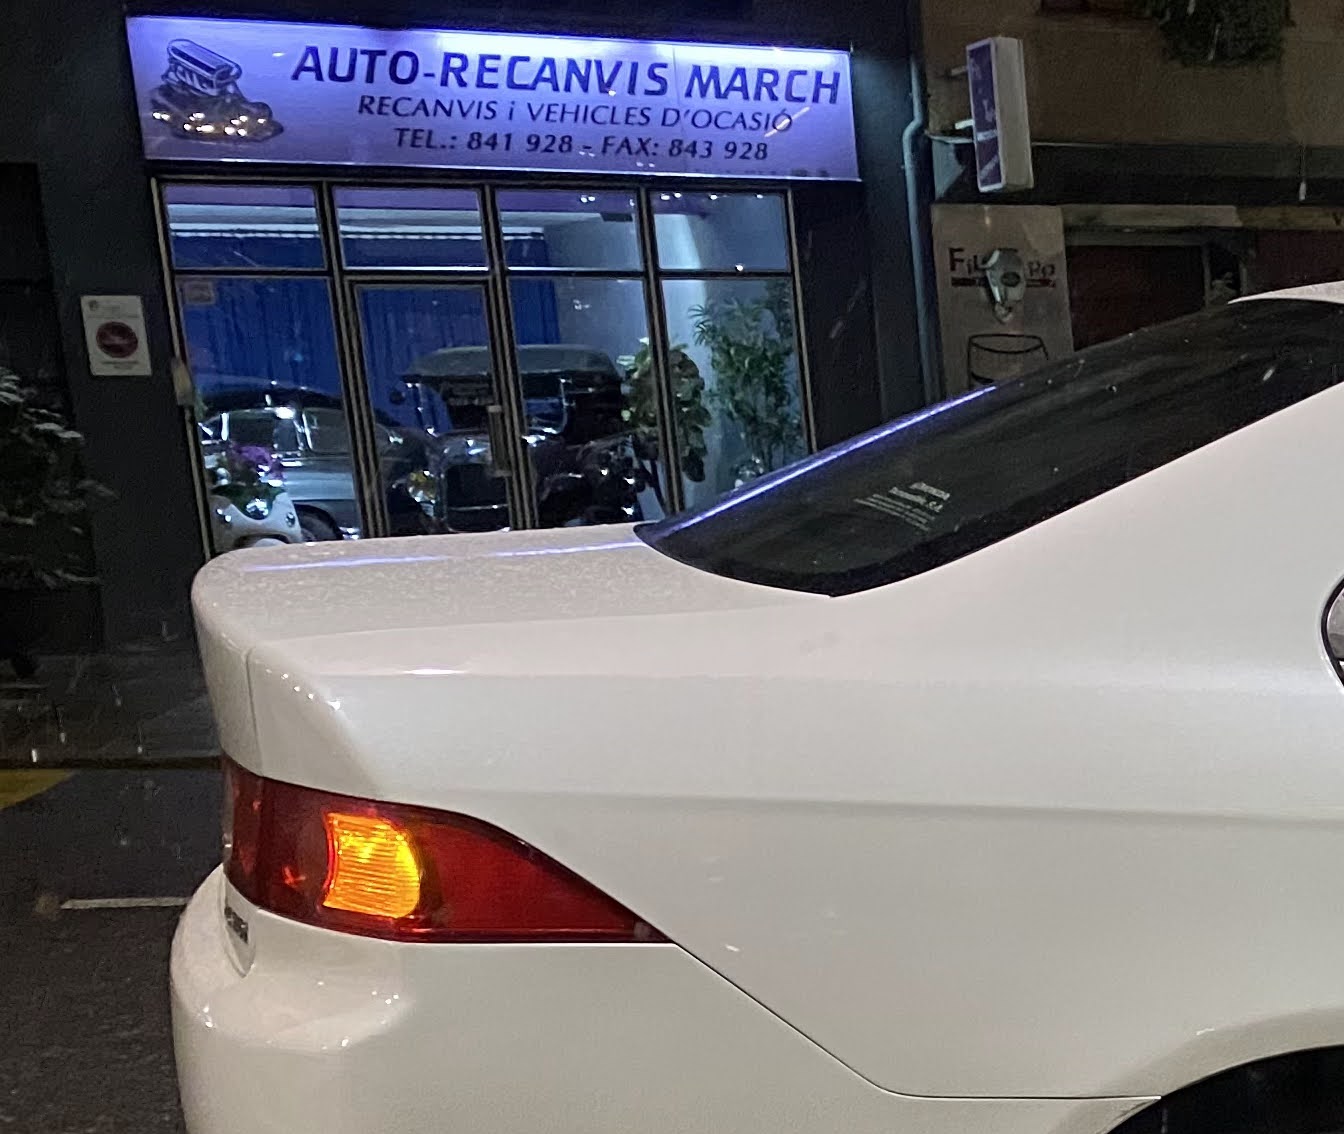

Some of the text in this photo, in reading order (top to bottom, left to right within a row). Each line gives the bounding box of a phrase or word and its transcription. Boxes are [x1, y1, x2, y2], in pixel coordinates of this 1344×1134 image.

[291, 46, 840, 104] AUTO-RECANVIS MARCH
[357, 95, 793, 132] RECANVIS i VEHICLES D'OCASIÓ
[394, 128, 456, 150] TEL.:
[466, 131, 512, 152] 841
[526, 134, 573, 153] 928
[601, 135, 659, 157] FAX:
[668, 138, 713, 158] 843
[724, 141, 768, 161] 928
